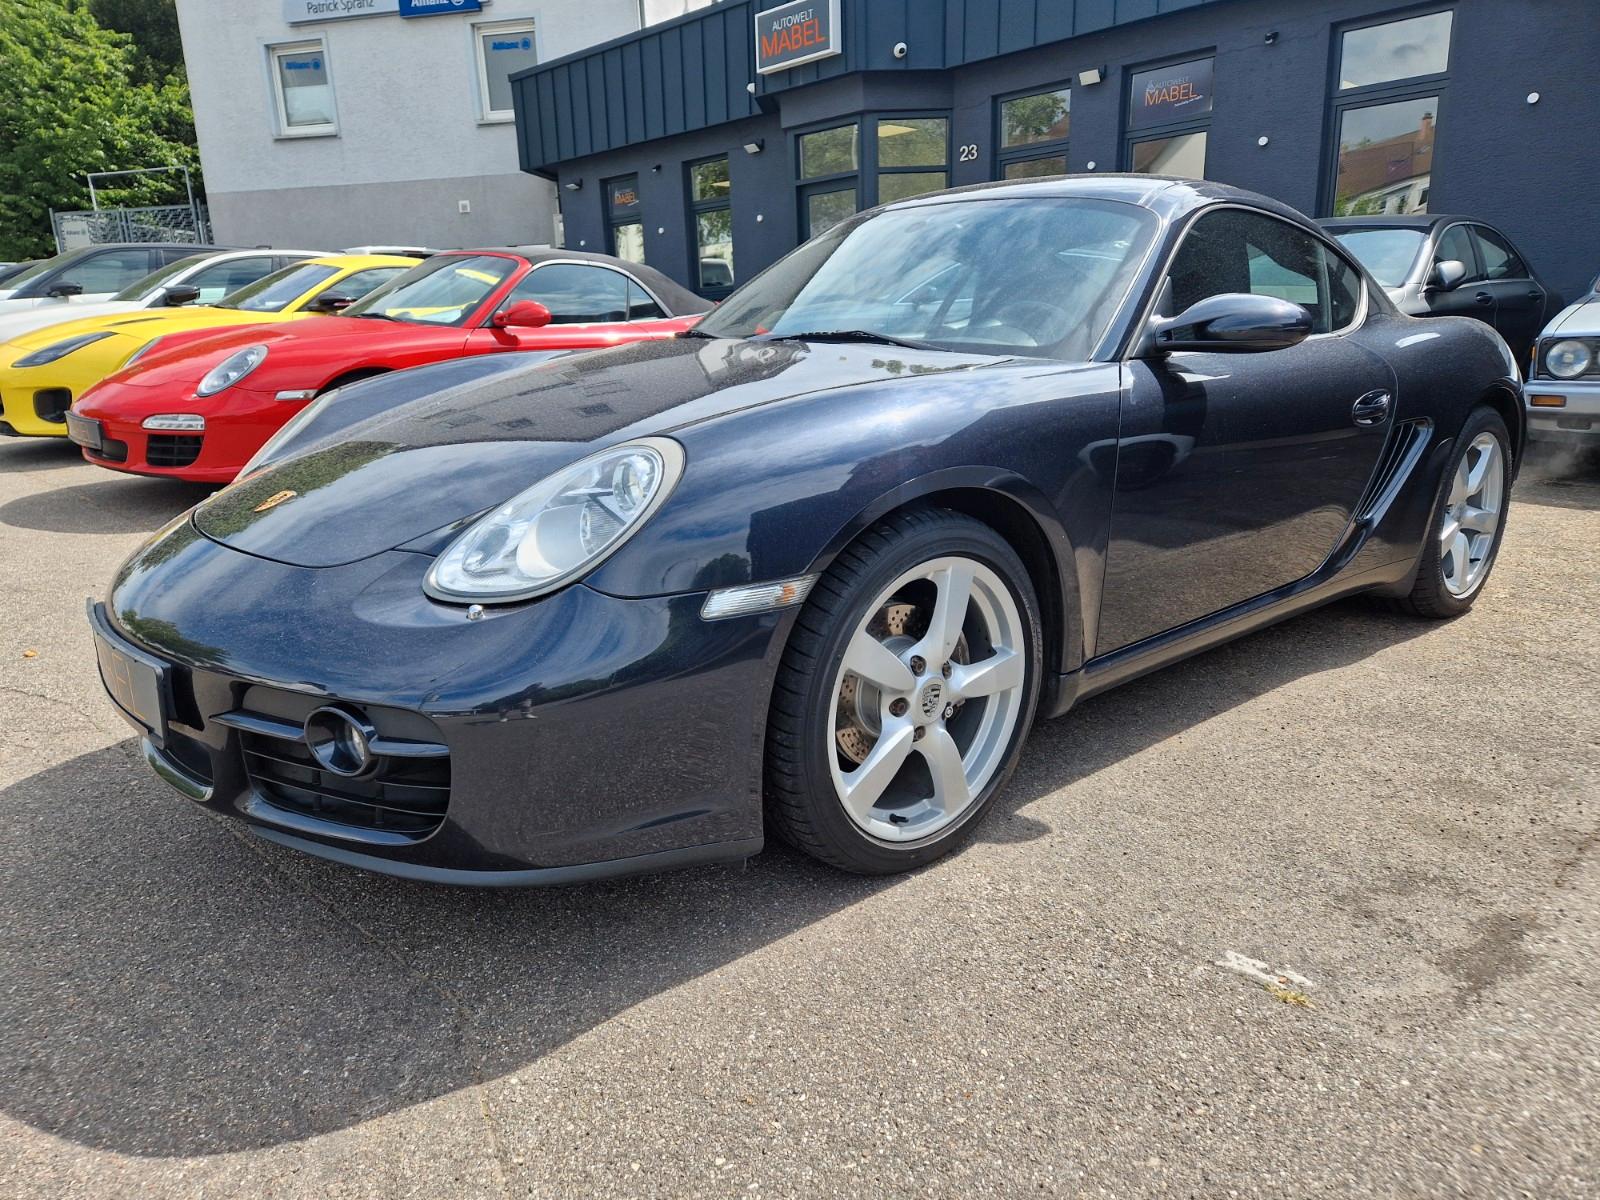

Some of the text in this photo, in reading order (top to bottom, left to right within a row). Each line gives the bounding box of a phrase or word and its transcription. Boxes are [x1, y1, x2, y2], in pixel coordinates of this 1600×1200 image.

[306, 0, 376, 15] Patrick Spranz
[772, 8, 815, 32] AUTOWELT
[761, 17, 828, 61] MABEL
[1145, 82, 1198, 107] MABEL
[959, 144, 978, 161] 23
